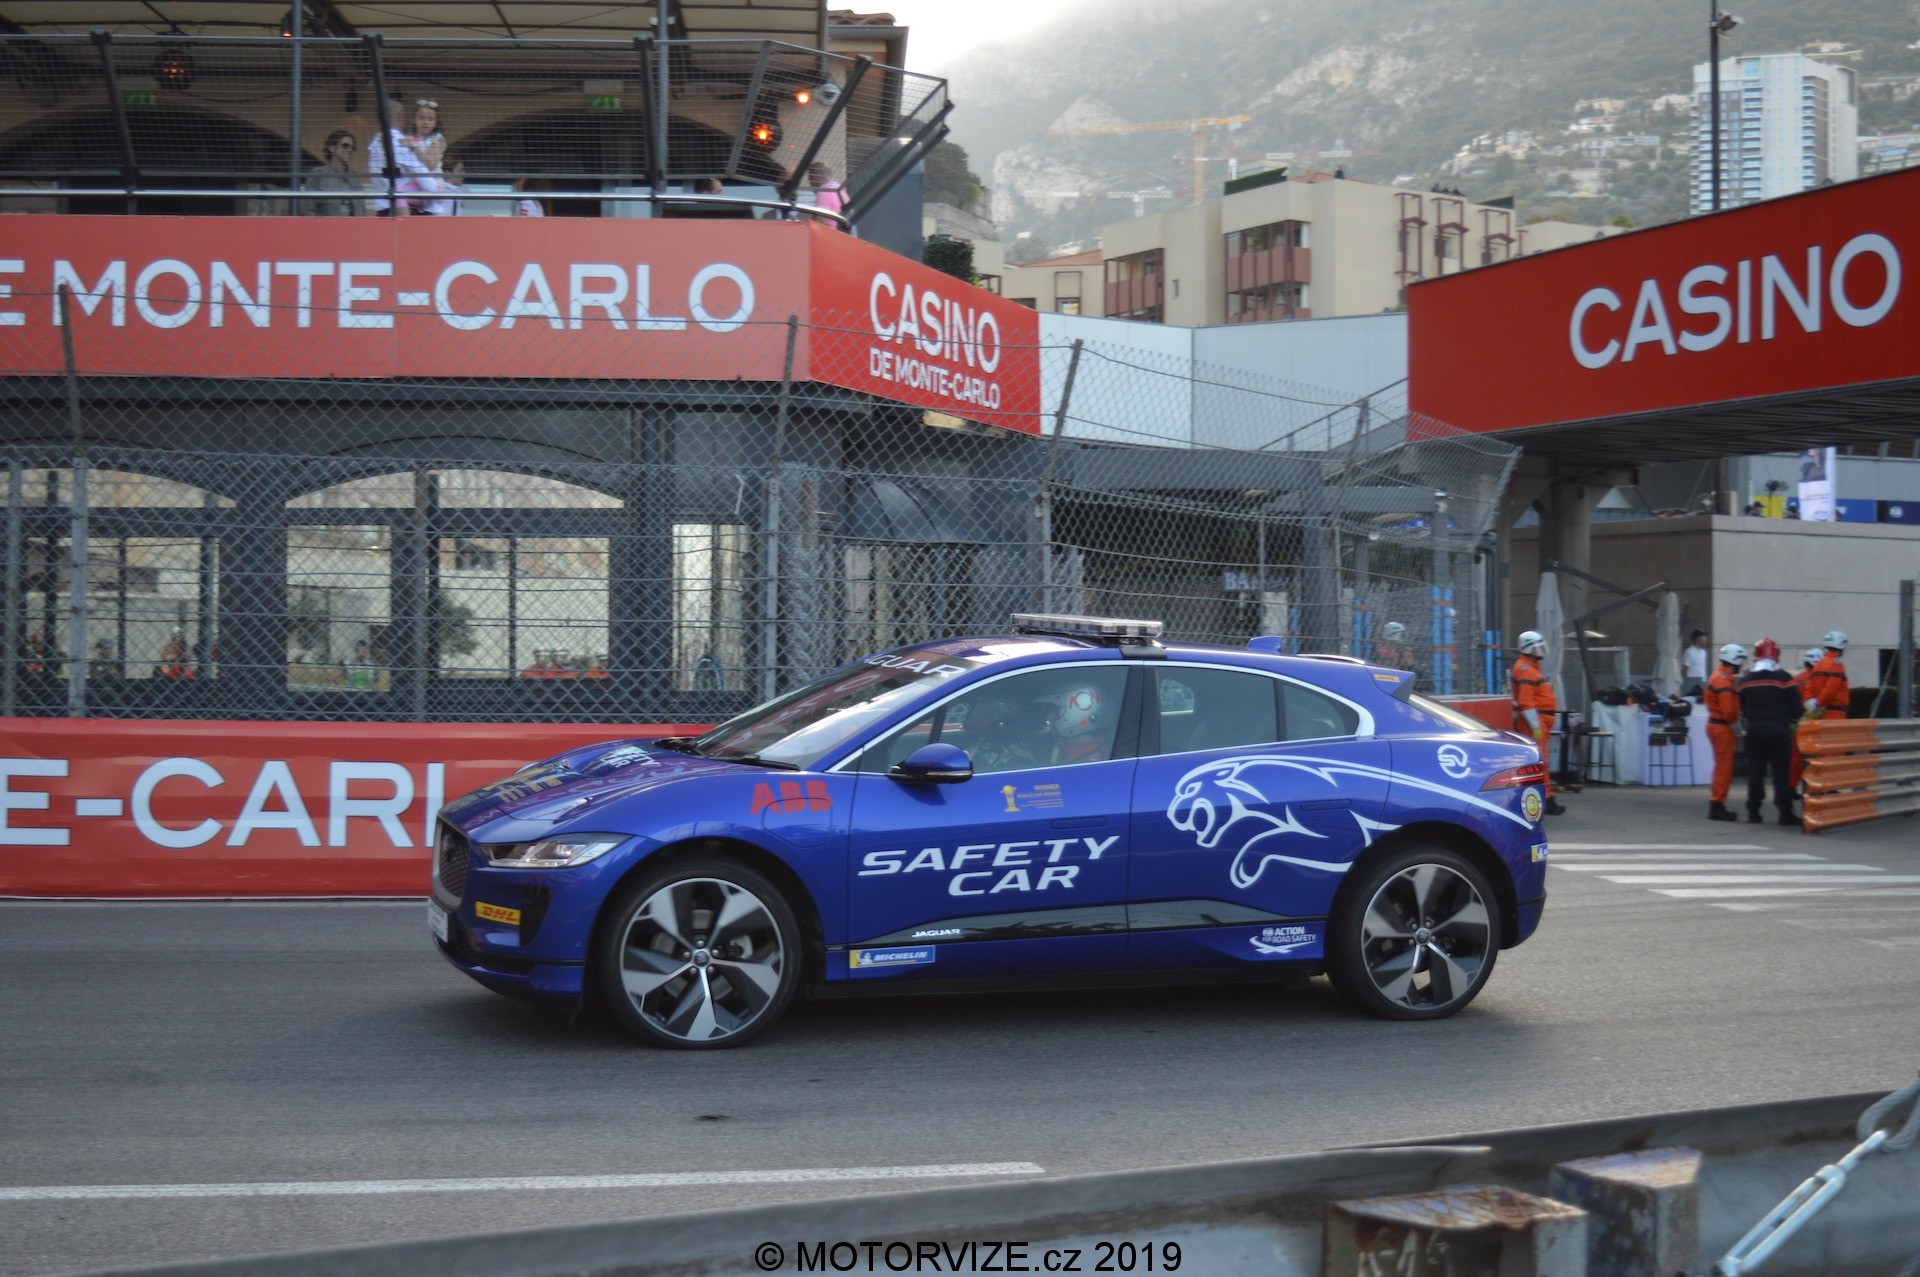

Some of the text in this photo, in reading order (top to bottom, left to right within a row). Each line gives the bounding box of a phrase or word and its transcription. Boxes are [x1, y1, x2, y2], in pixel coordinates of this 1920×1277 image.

[52, 258, 755, 333] MONTE-CARLO
[1568, 232, 1902, 370] CASINO
[869, 271, 1001, 374] CASINO
[869, 347, 1001, 410] DE MONTE-CARLO
[863, 653, 967, 679] GUAR
[750, 780, 832, 815] ABB
[858, 835, 1120, 876] SAFETY
[948, 865, 1080, 896] CAR
[481, 905, 517, 922] DHL
[911, 928, 961, 938] JAGUAR
[1273, 935, 1291, 944] ROAD
[1291, 933, 1317, 942] SAFETY
[1274, 926, 1305, 936] ACTION
[873, 951, 928, 962] MICHELIN
